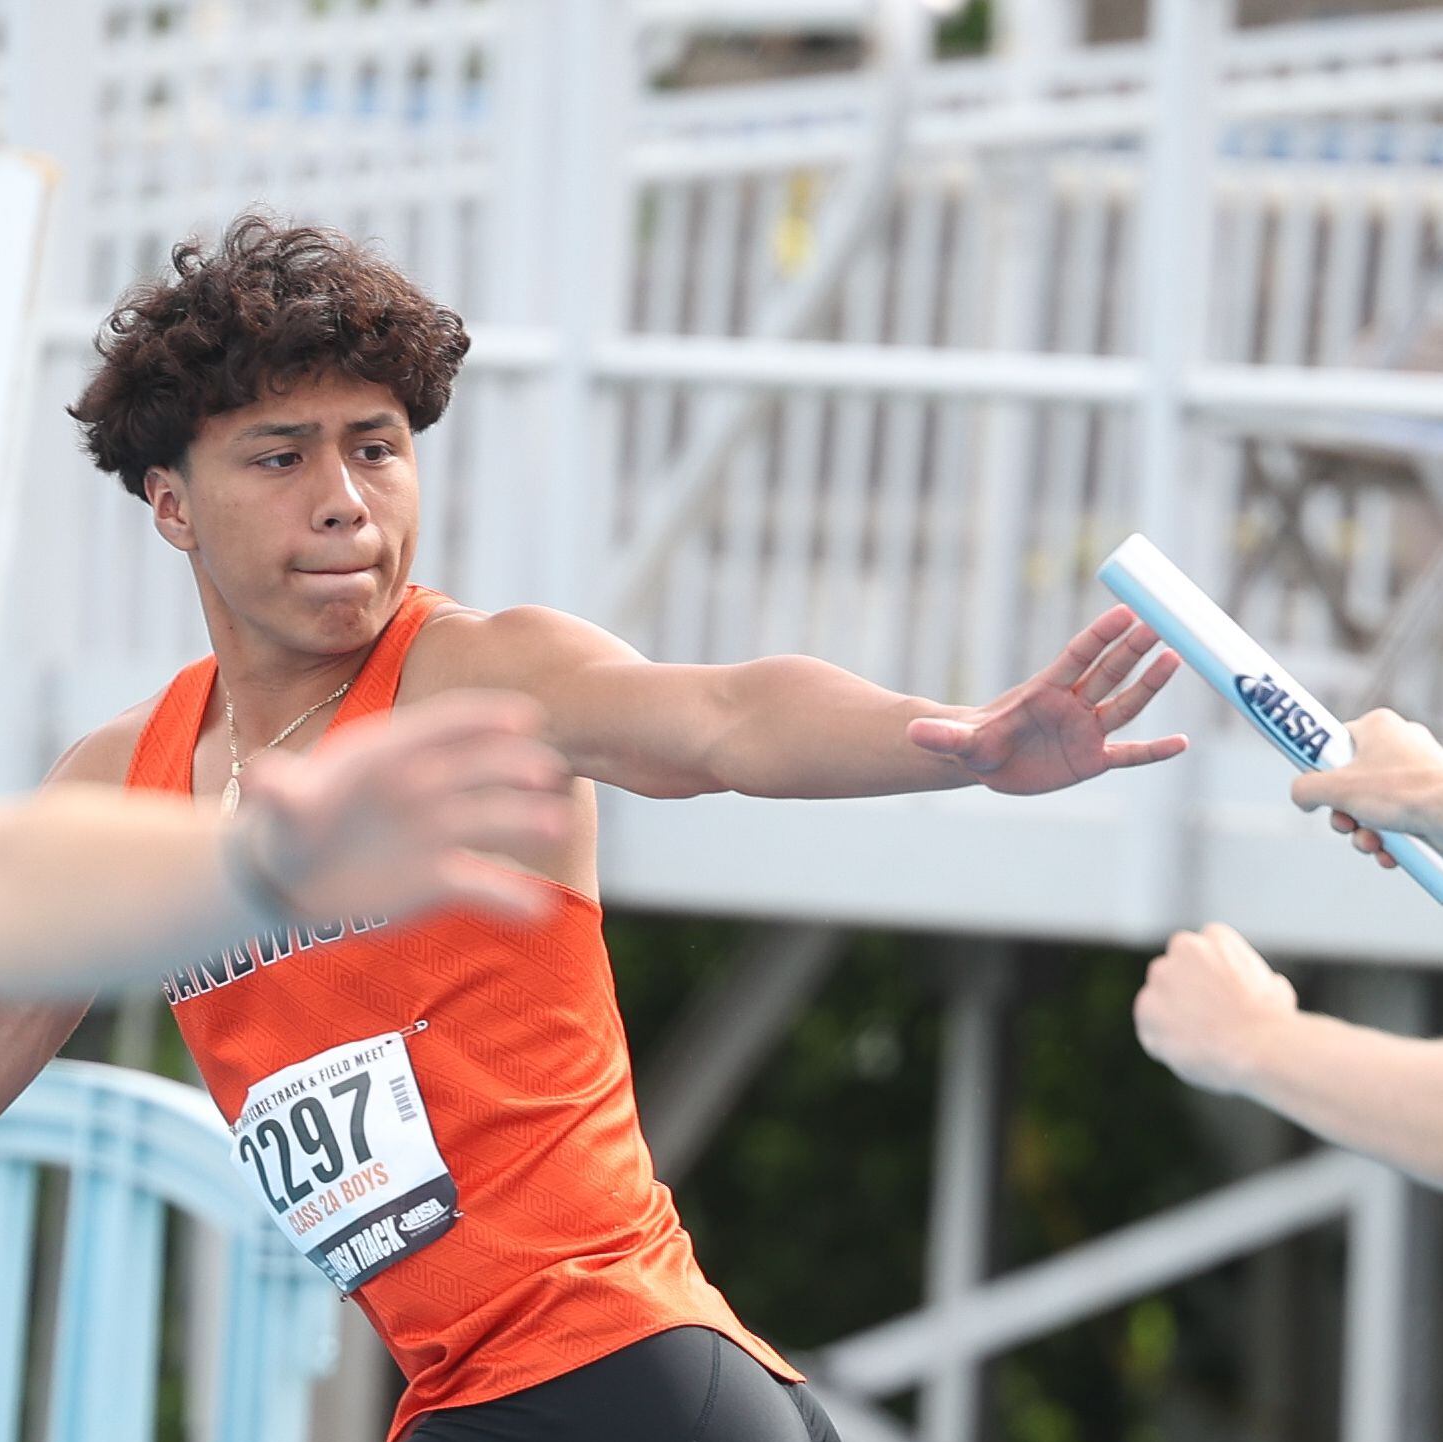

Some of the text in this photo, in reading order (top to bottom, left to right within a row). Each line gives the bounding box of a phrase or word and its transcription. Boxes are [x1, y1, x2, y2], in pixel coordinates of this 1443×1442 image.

[271, 1080, 307, 1107] TRACK
[309, 1076, 318, 1088] &
[319, 1059, 352, 1083] FIELD
[355, 1045, 386, 1068] MEET
[239, 1070, 373, 1215] 2297
[287, 1162, 390, 1237] CLASS 2A BOYS
[348, 1215, 407, 1270] TRACK
